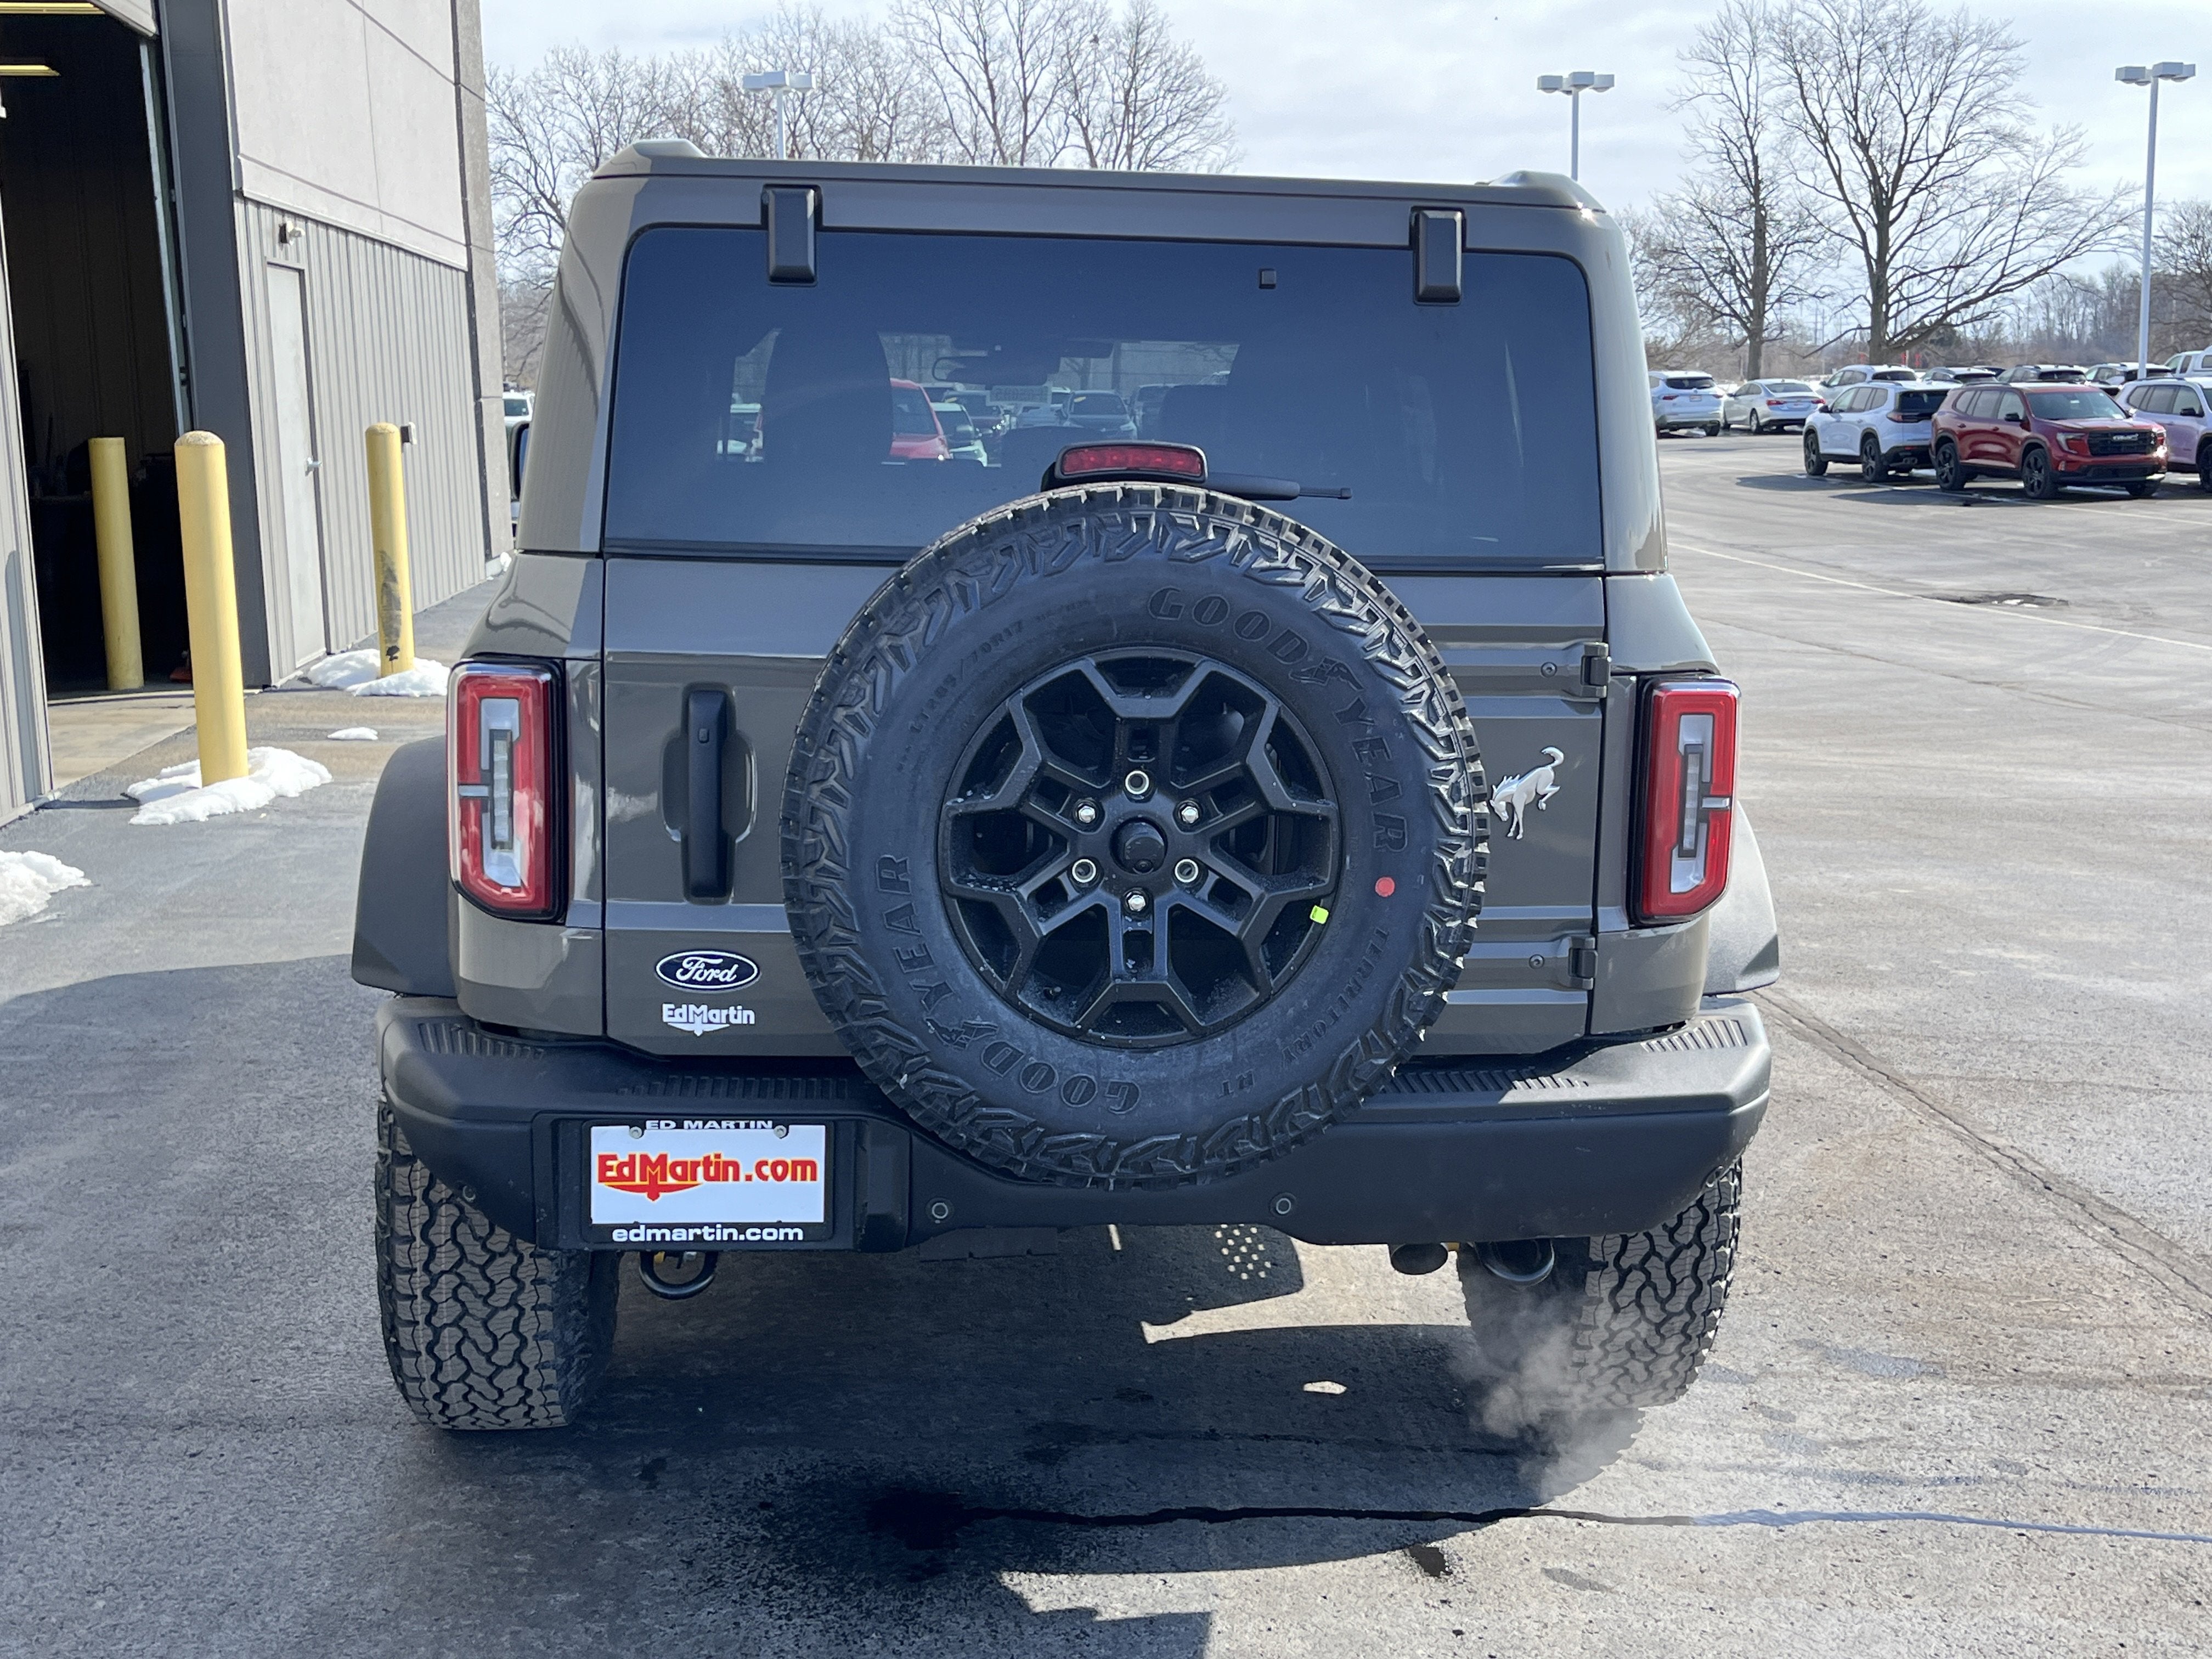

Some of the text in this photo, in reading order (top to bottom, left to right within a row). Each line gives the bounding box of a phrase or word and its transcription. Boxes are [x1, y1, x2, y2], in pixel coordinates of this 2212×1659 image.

[676, 956, 738, 983] Ford
[1219, 926, 1390, 1097] TERRITORY RT
[646, 1120, 772, 1130] ED MARTIN
[612, 1225, 803, 1242] edmartin.com
